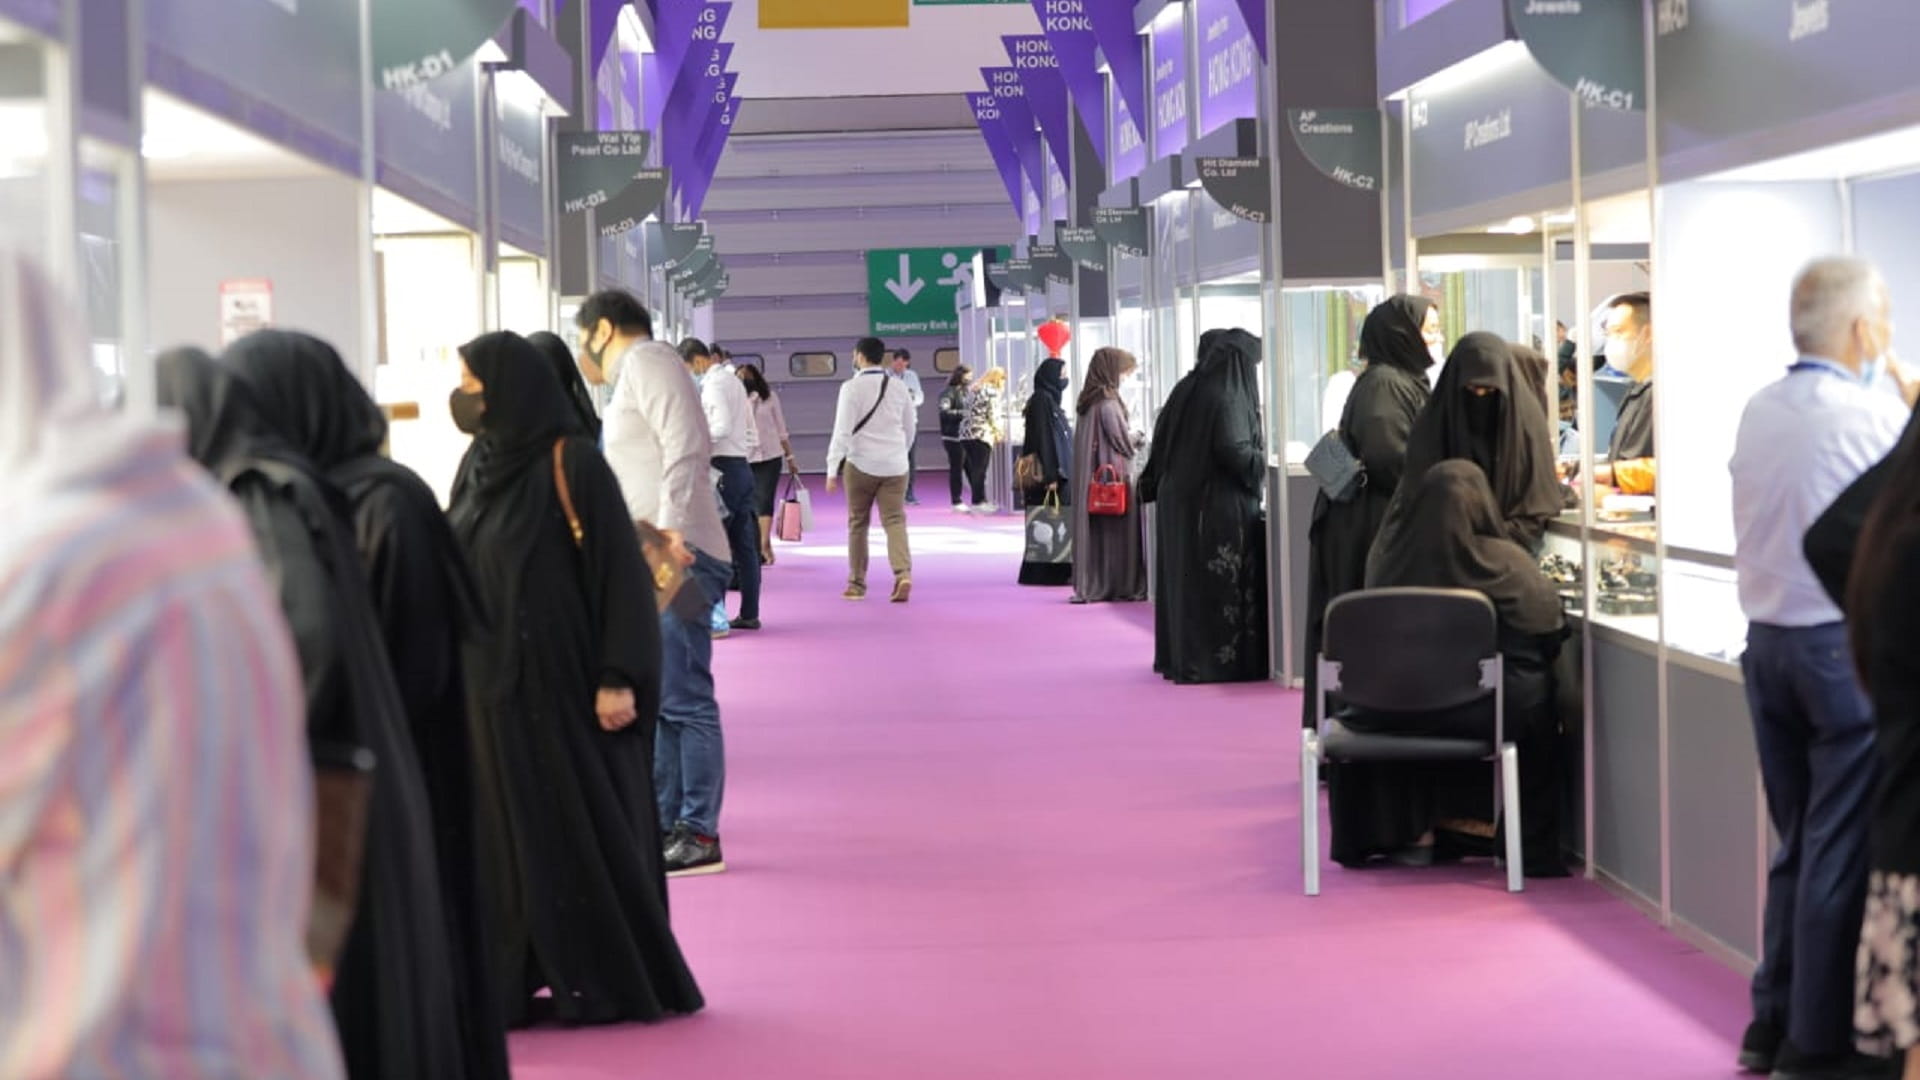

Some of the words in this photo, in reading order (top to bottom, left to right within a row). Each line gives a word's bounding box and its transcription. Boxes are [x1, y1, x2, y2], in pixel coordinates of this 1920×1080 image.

[1046, 0, 1082, 13] HON
[1016, 40, 1053, 53] HON
[383, 49, 455, 89] HK-D1
[994, 85, 1023, 97] KON
[1575, 77, 1633, 109] HK-C1
[977, 96, 995, 107] HO
[1300, 111, 1316, 121] AP
[1300, 124, 1353, 134] Creations
[572, 144, 600, 156] Pearl
[622, 145, 641, 155] Ltd
[1219, 159, 1259, 168] Diamond
[1222, 168, 1237, 177] Ltd
[1333, 165, 1374, 190] HK-C2
[876, 322, 927, 332] Emergency
[929, 320, 948, 329] Exit
